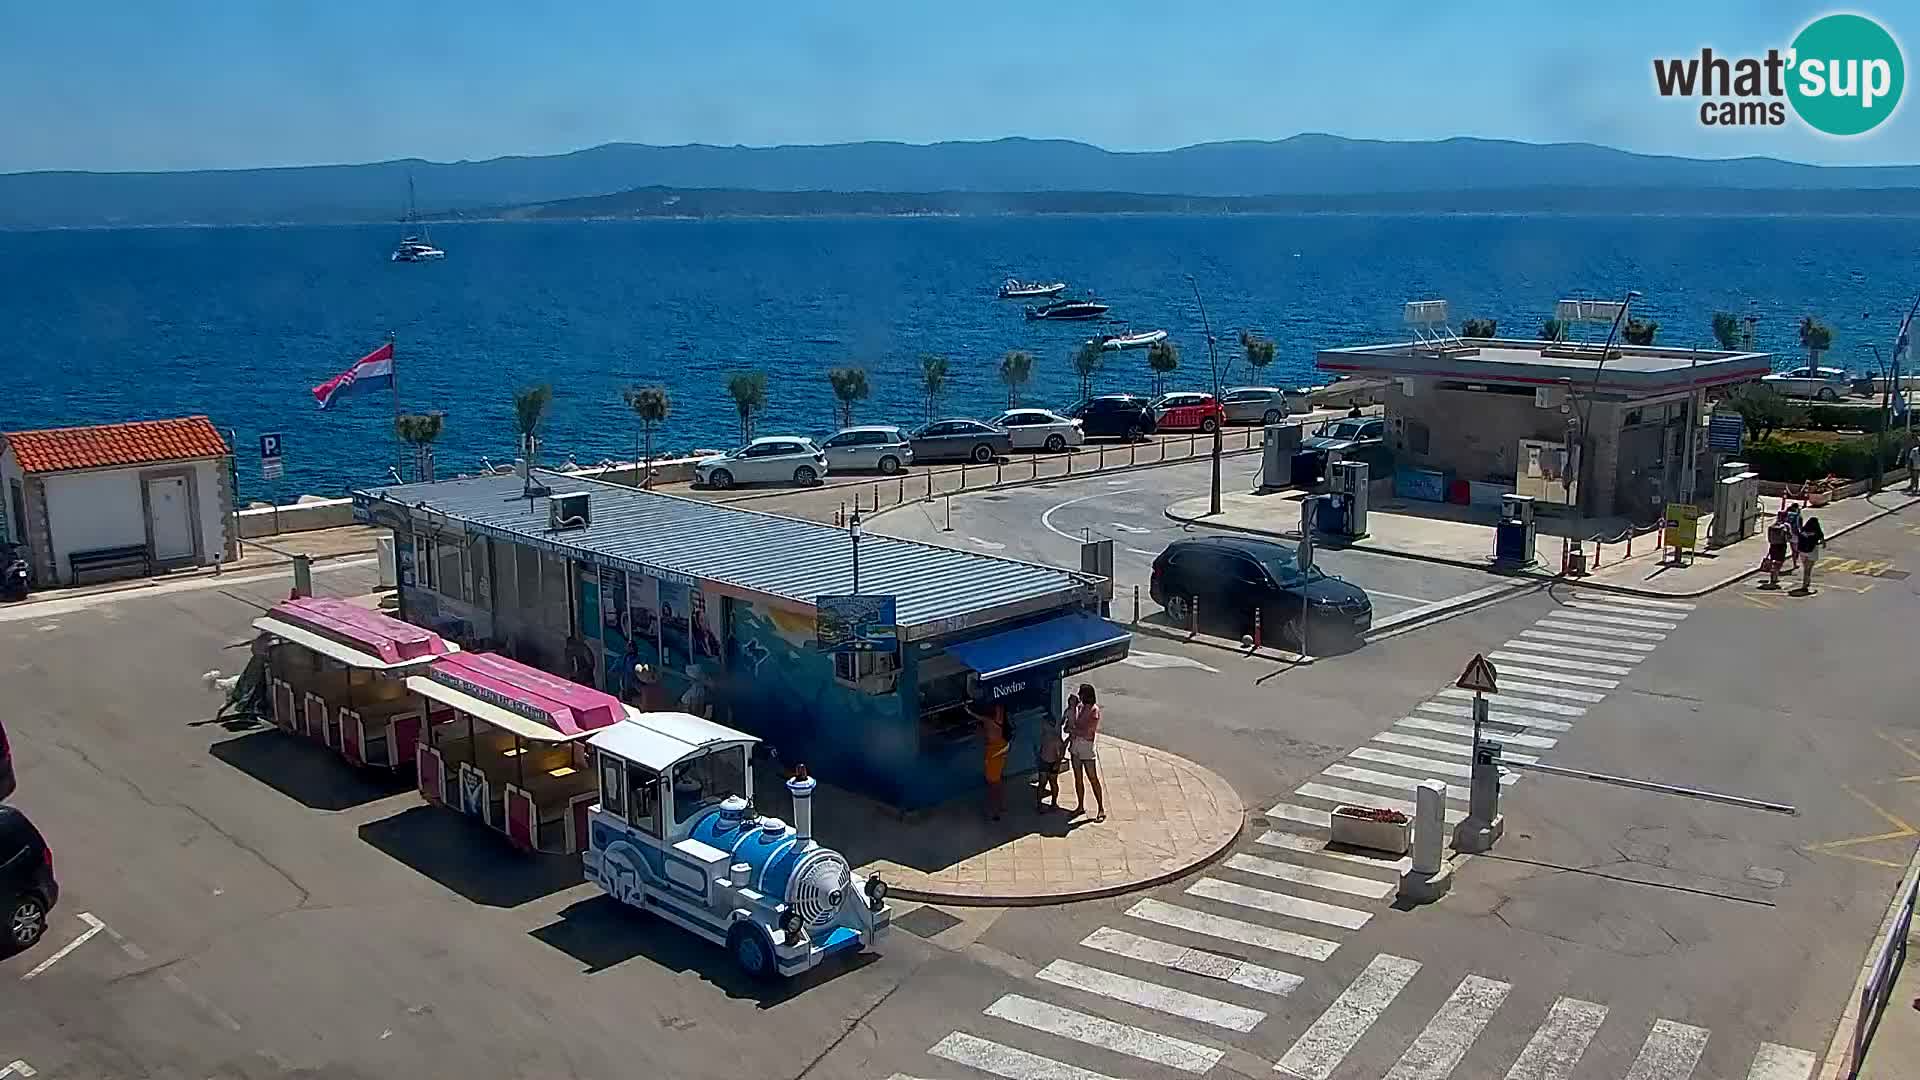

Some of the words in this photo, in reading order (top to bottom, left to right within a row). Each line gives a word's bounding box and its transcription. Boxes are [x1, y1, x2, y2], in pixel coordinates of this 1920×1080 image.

[265, 437, 277, 455] P
[609, 558, 641, 573] STATION
[668, 572, 695, 587] OFFICE
